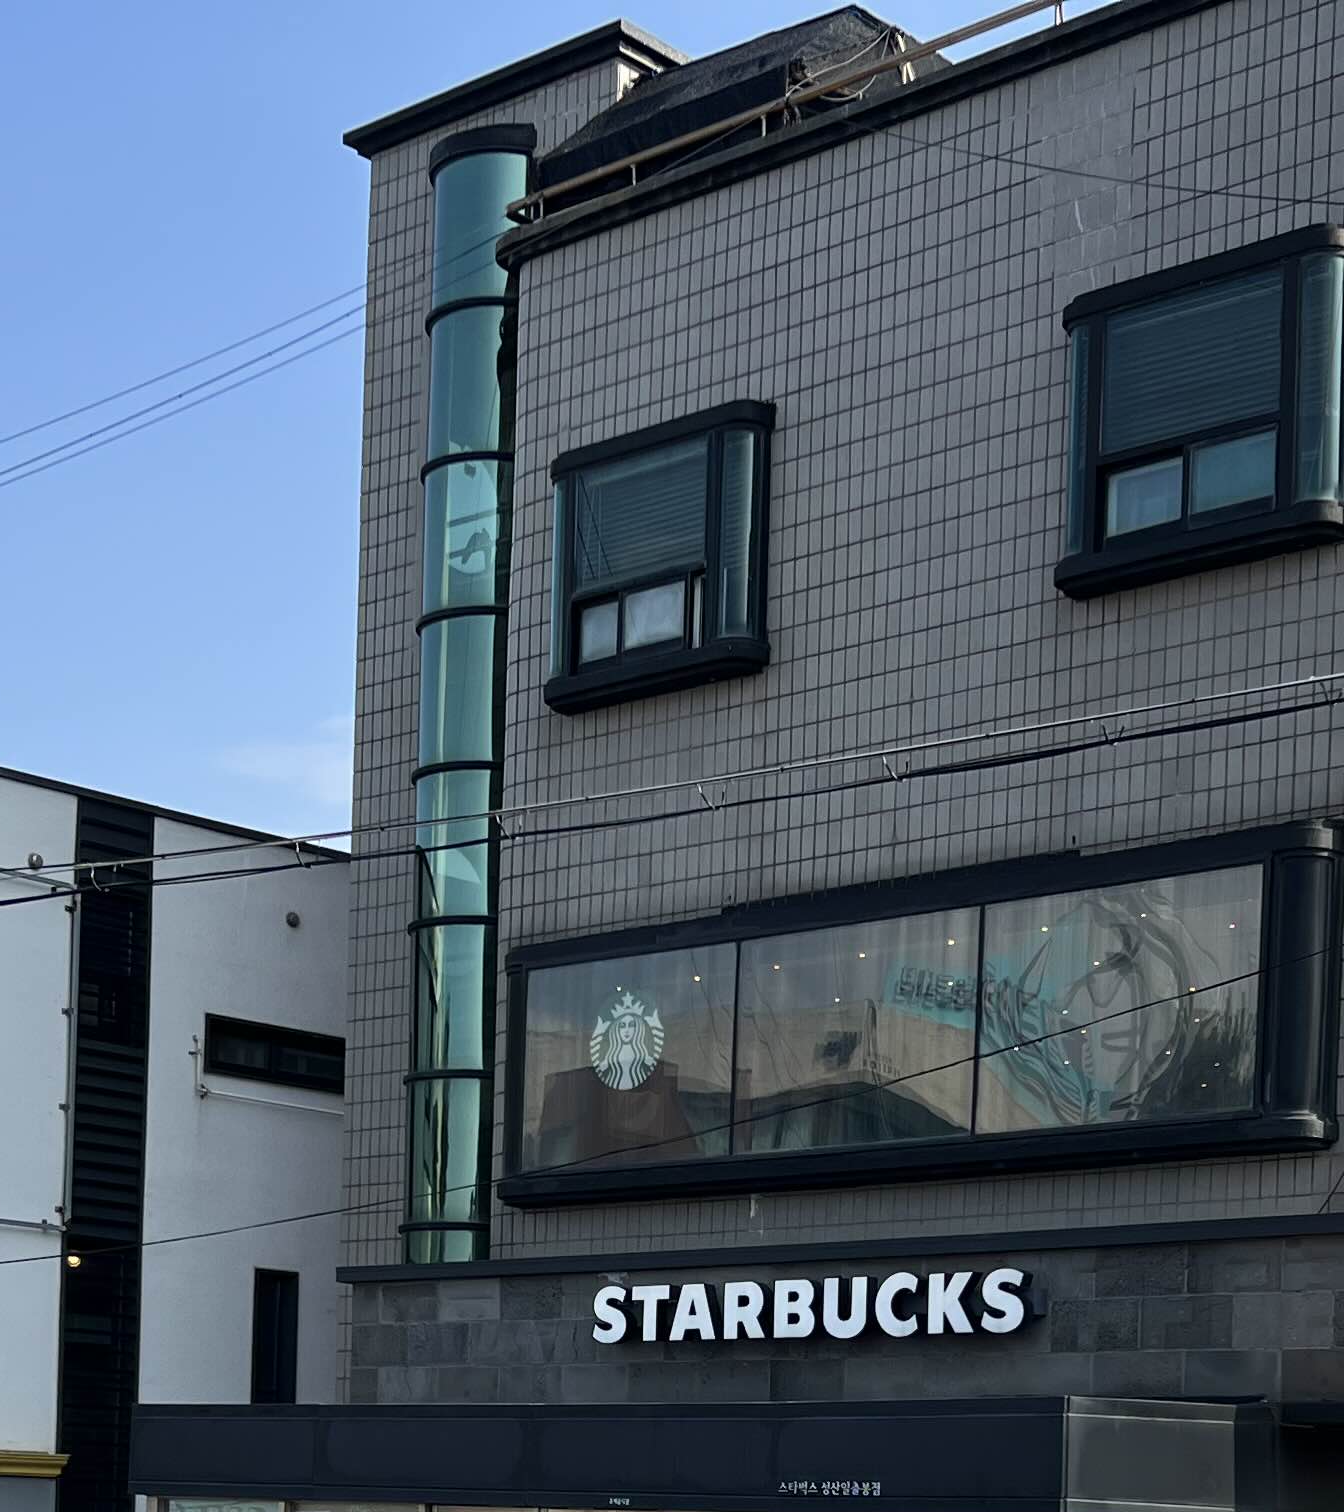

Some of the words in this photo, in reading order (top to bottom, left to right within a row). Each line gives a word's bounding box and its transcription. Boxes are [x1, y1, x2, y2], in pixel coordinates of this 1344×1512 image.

[592, 1268, 1025, 1344] STARBUCKS
[777, 1480, 818, 1495] 스타벅스
[820, 1480, 881, 1496] 성산일출봉점
